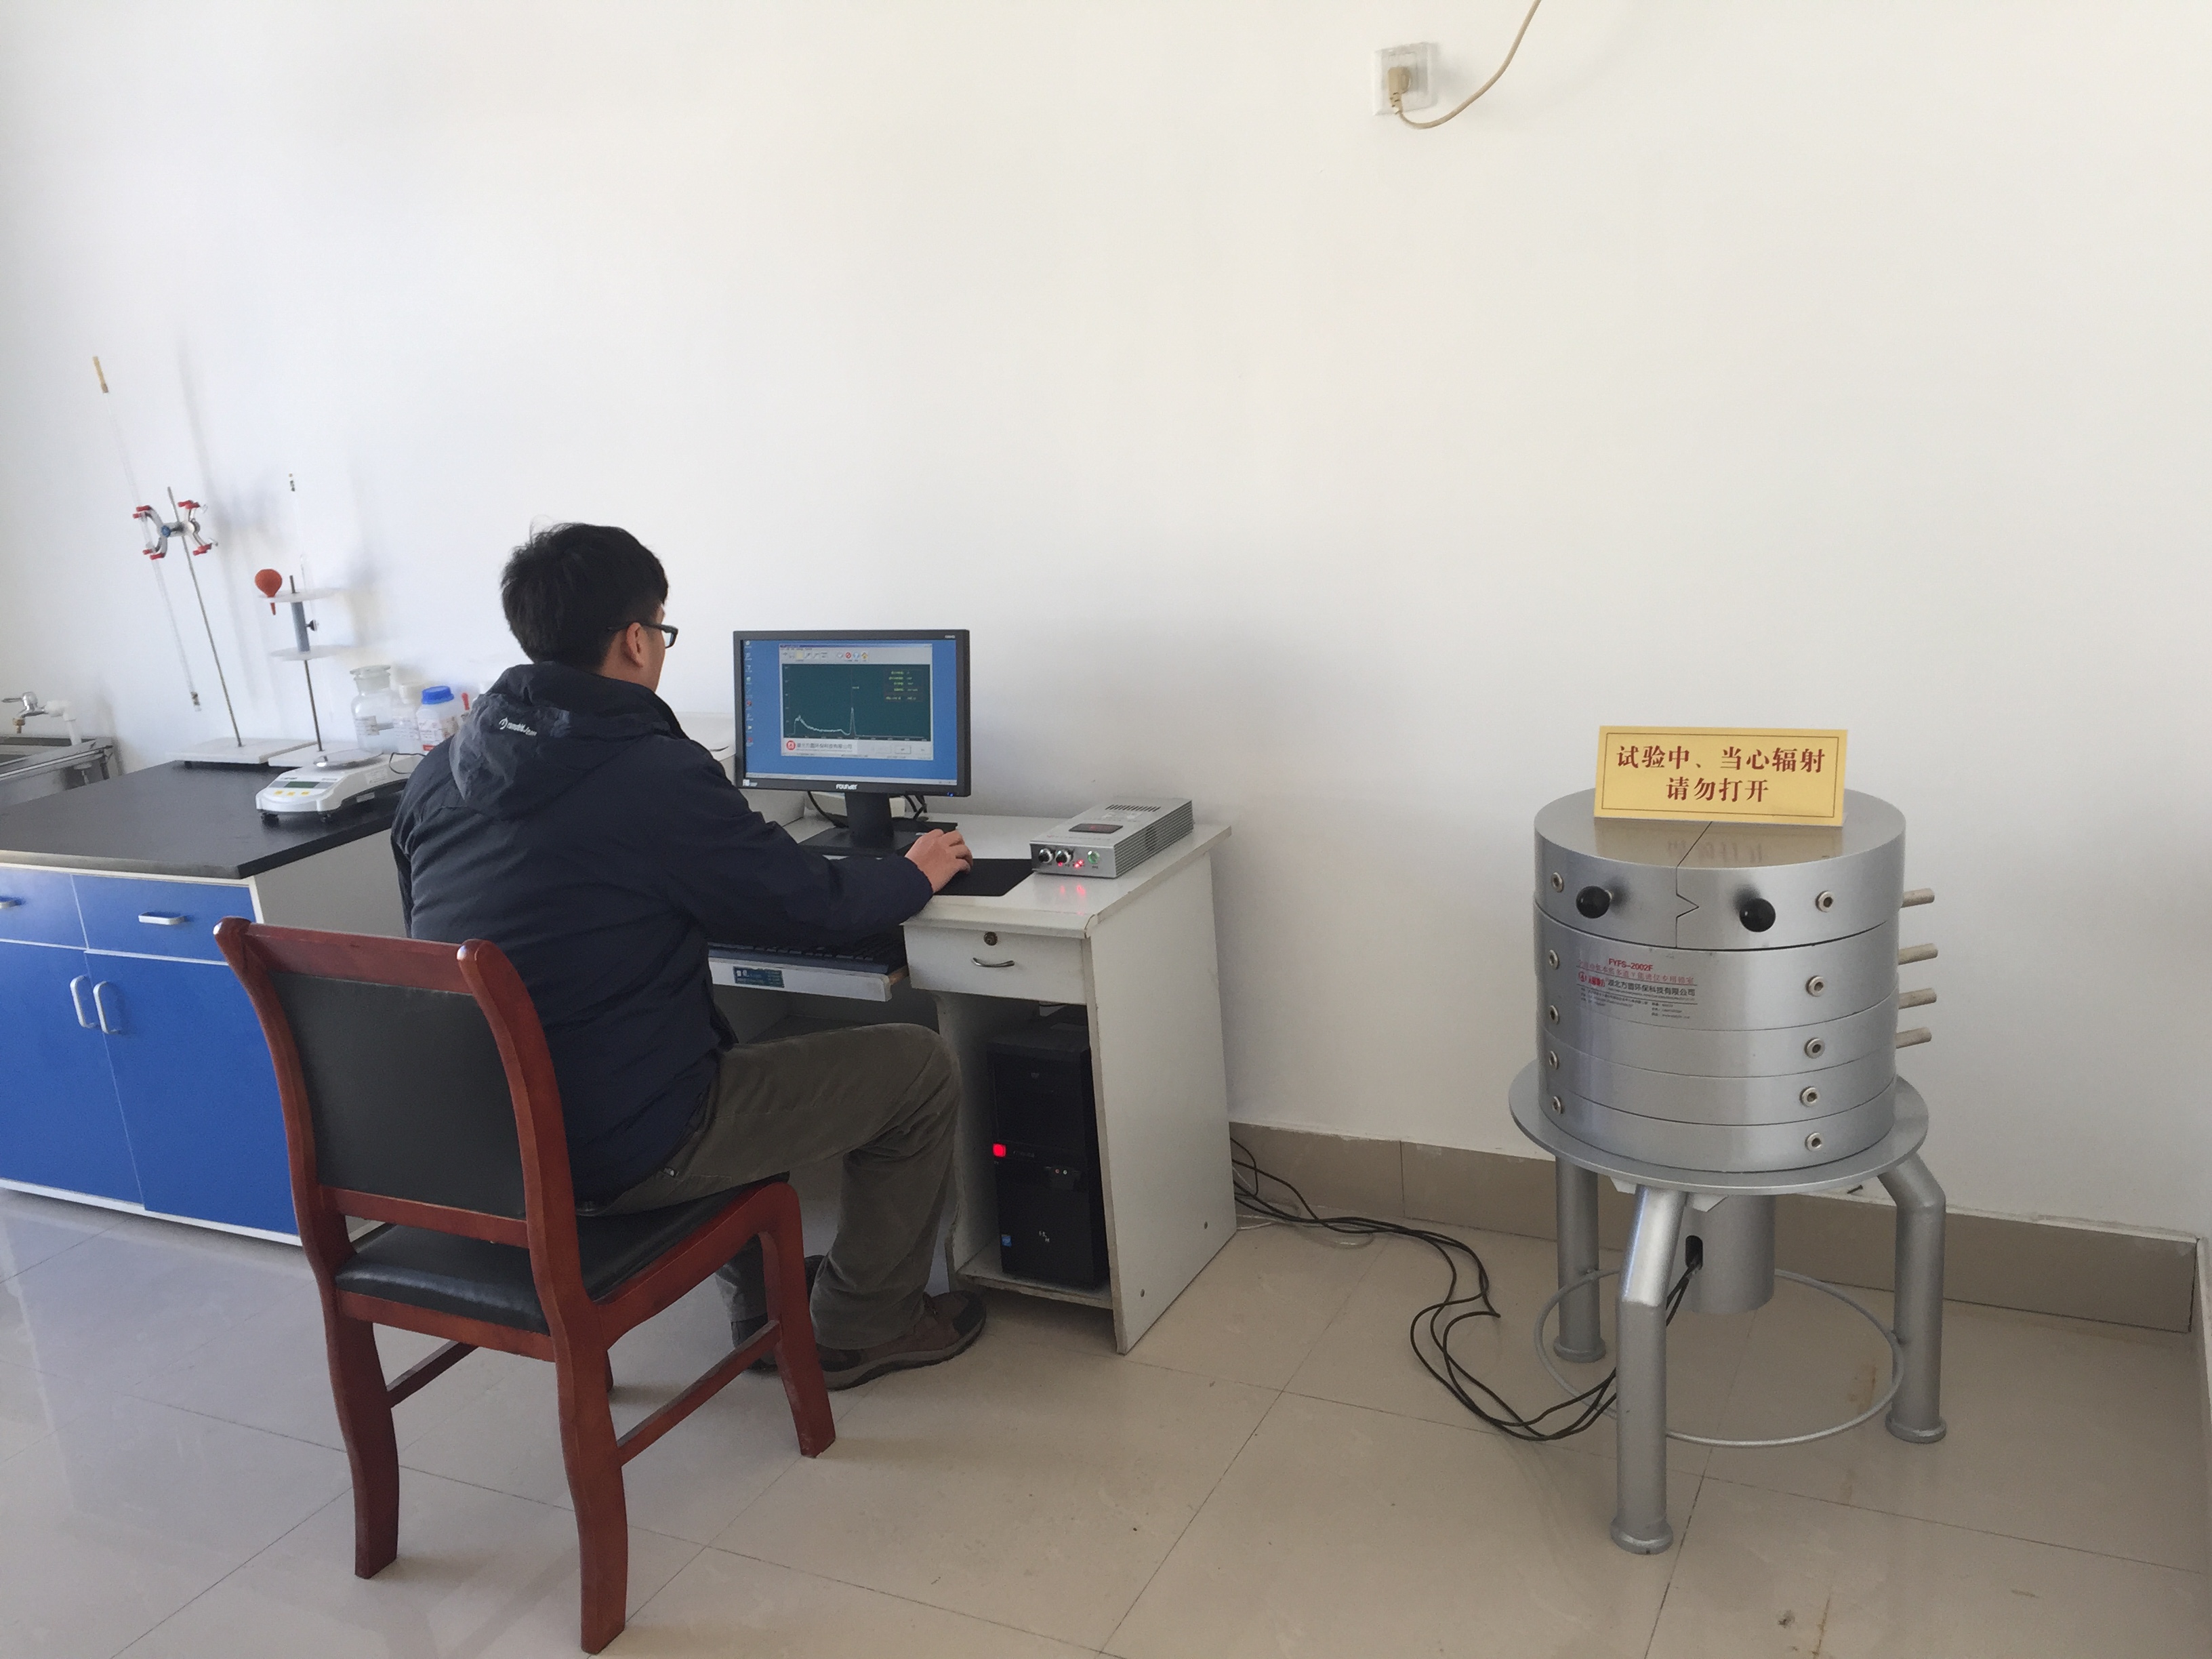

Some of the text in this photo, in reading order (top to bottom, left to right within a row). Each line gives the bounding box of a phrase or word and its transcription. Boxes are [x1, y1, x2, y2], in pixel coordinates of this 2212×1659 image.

[1617, 745, 1825, 773] 试验中、当心辐射
[1666, 777, 1769, 802] 请勿打开
[1608, 958, 1654, 971] FYFS-2002F
